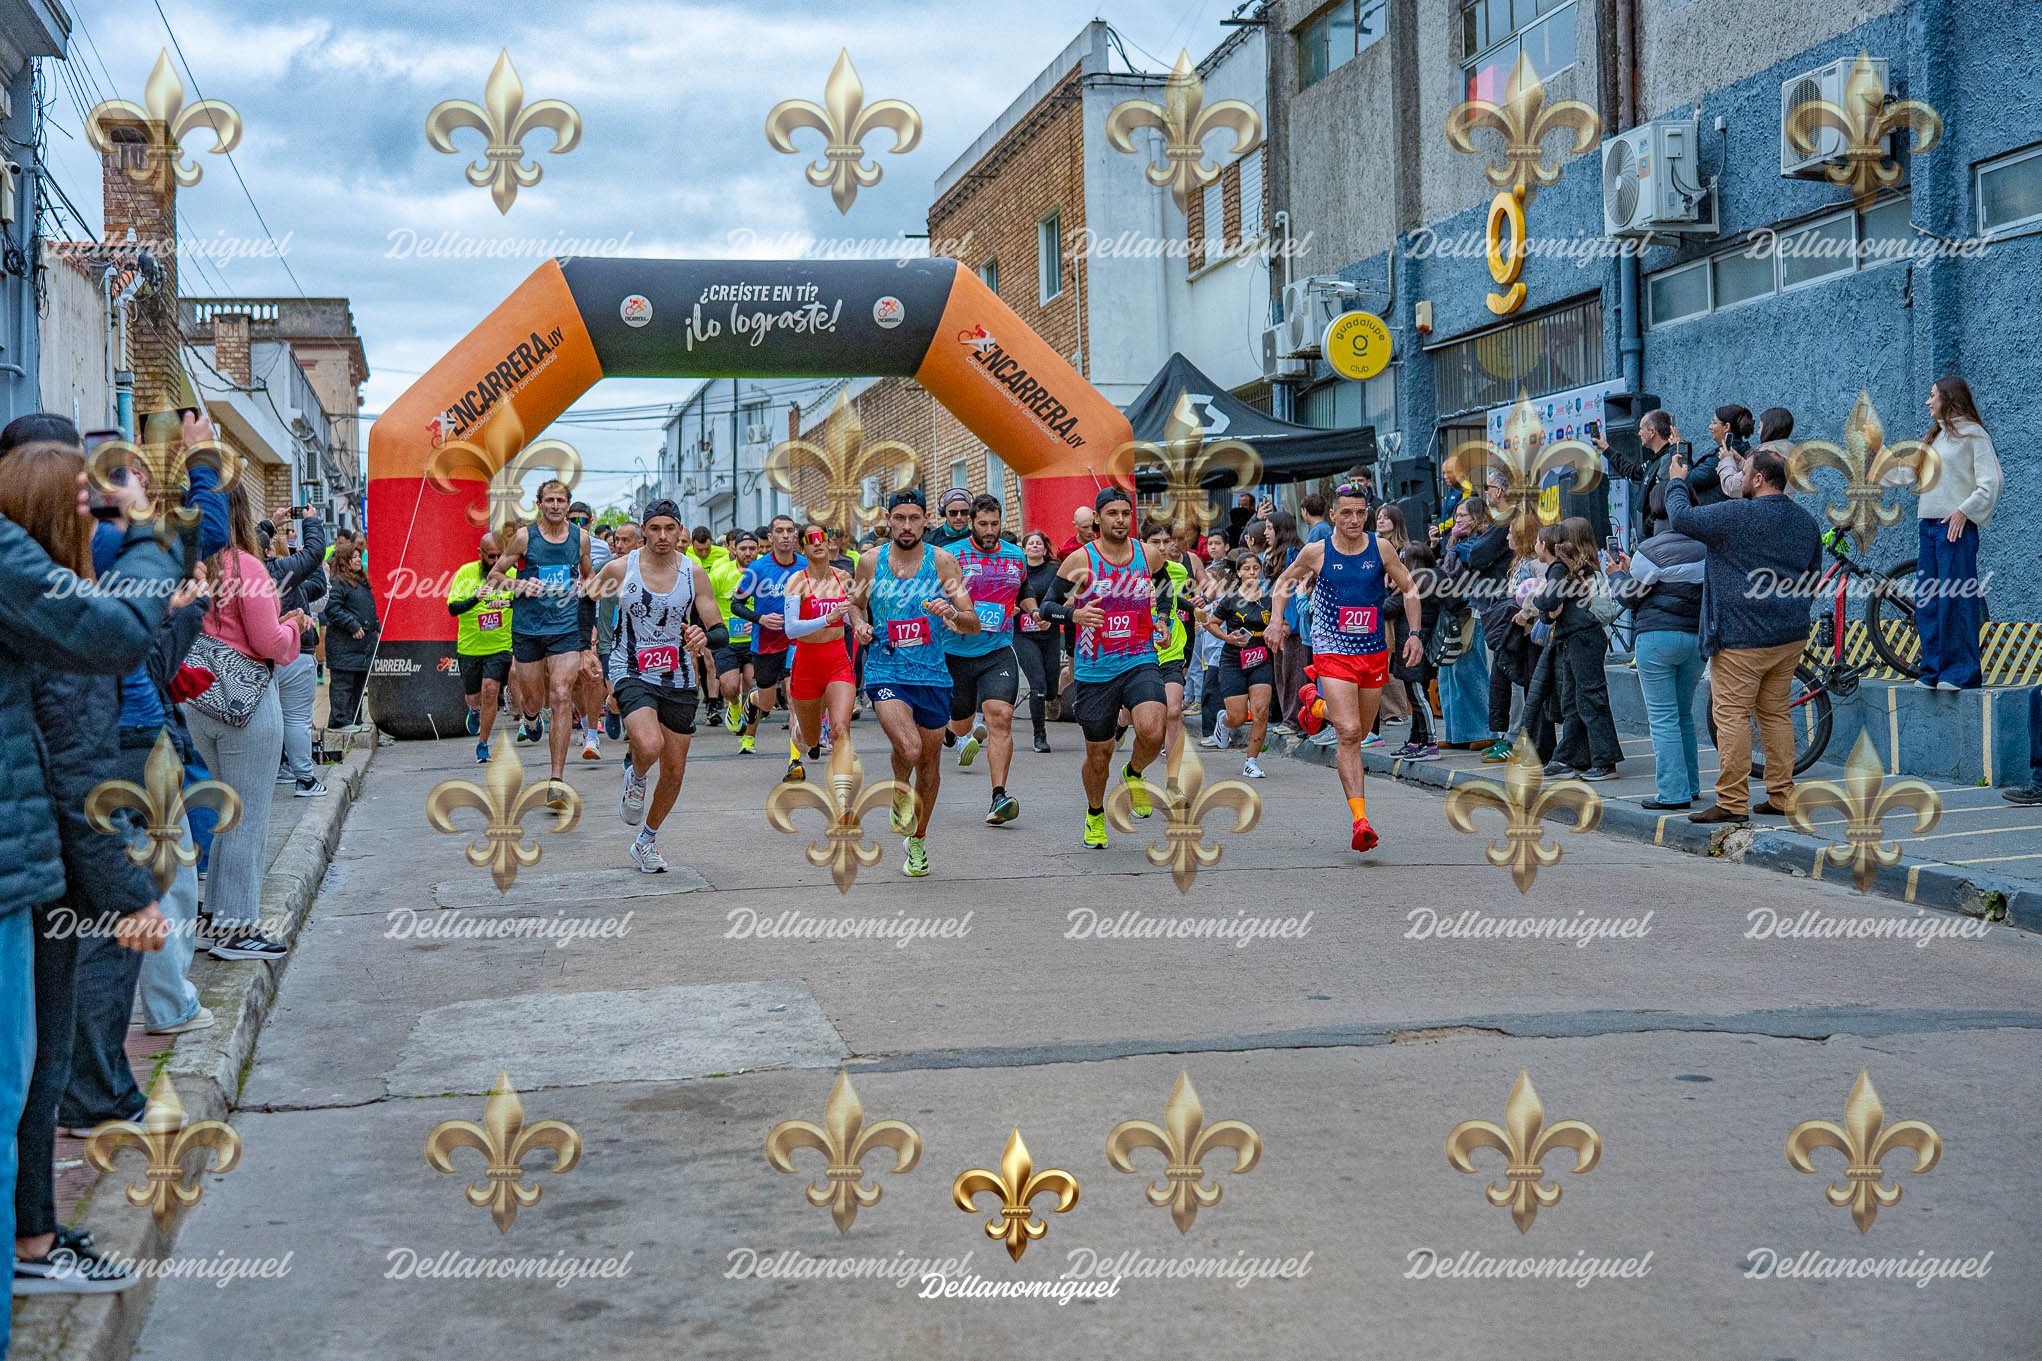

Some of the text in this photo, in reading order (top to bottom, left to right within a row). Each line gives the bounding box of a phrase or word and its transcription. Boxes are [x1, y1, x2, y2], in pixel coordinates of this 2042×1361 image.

[699, 282, 819, 304] ¿CREÍSTE EN TÍ?
[731, 299, 843, 347] lograste!
[1336, 318, 1385, 341] guadalupe
[1350, 364, 1369, 373] club
[446, 326, 565, 436] ENCARRERA.UY
[972, 343, 1087, 449] ENCARRERA.UY
[482, 614, 499, 626] 245
[979, 610, 1000, 625] 425
[1108, 616, 1130, 630] 199
[1345, 611, 1371, 626] 207
[896, 622, 920, 640] 179
[644, 650, 672, 668] 234
[1245, 652, 1264, 664] 224
